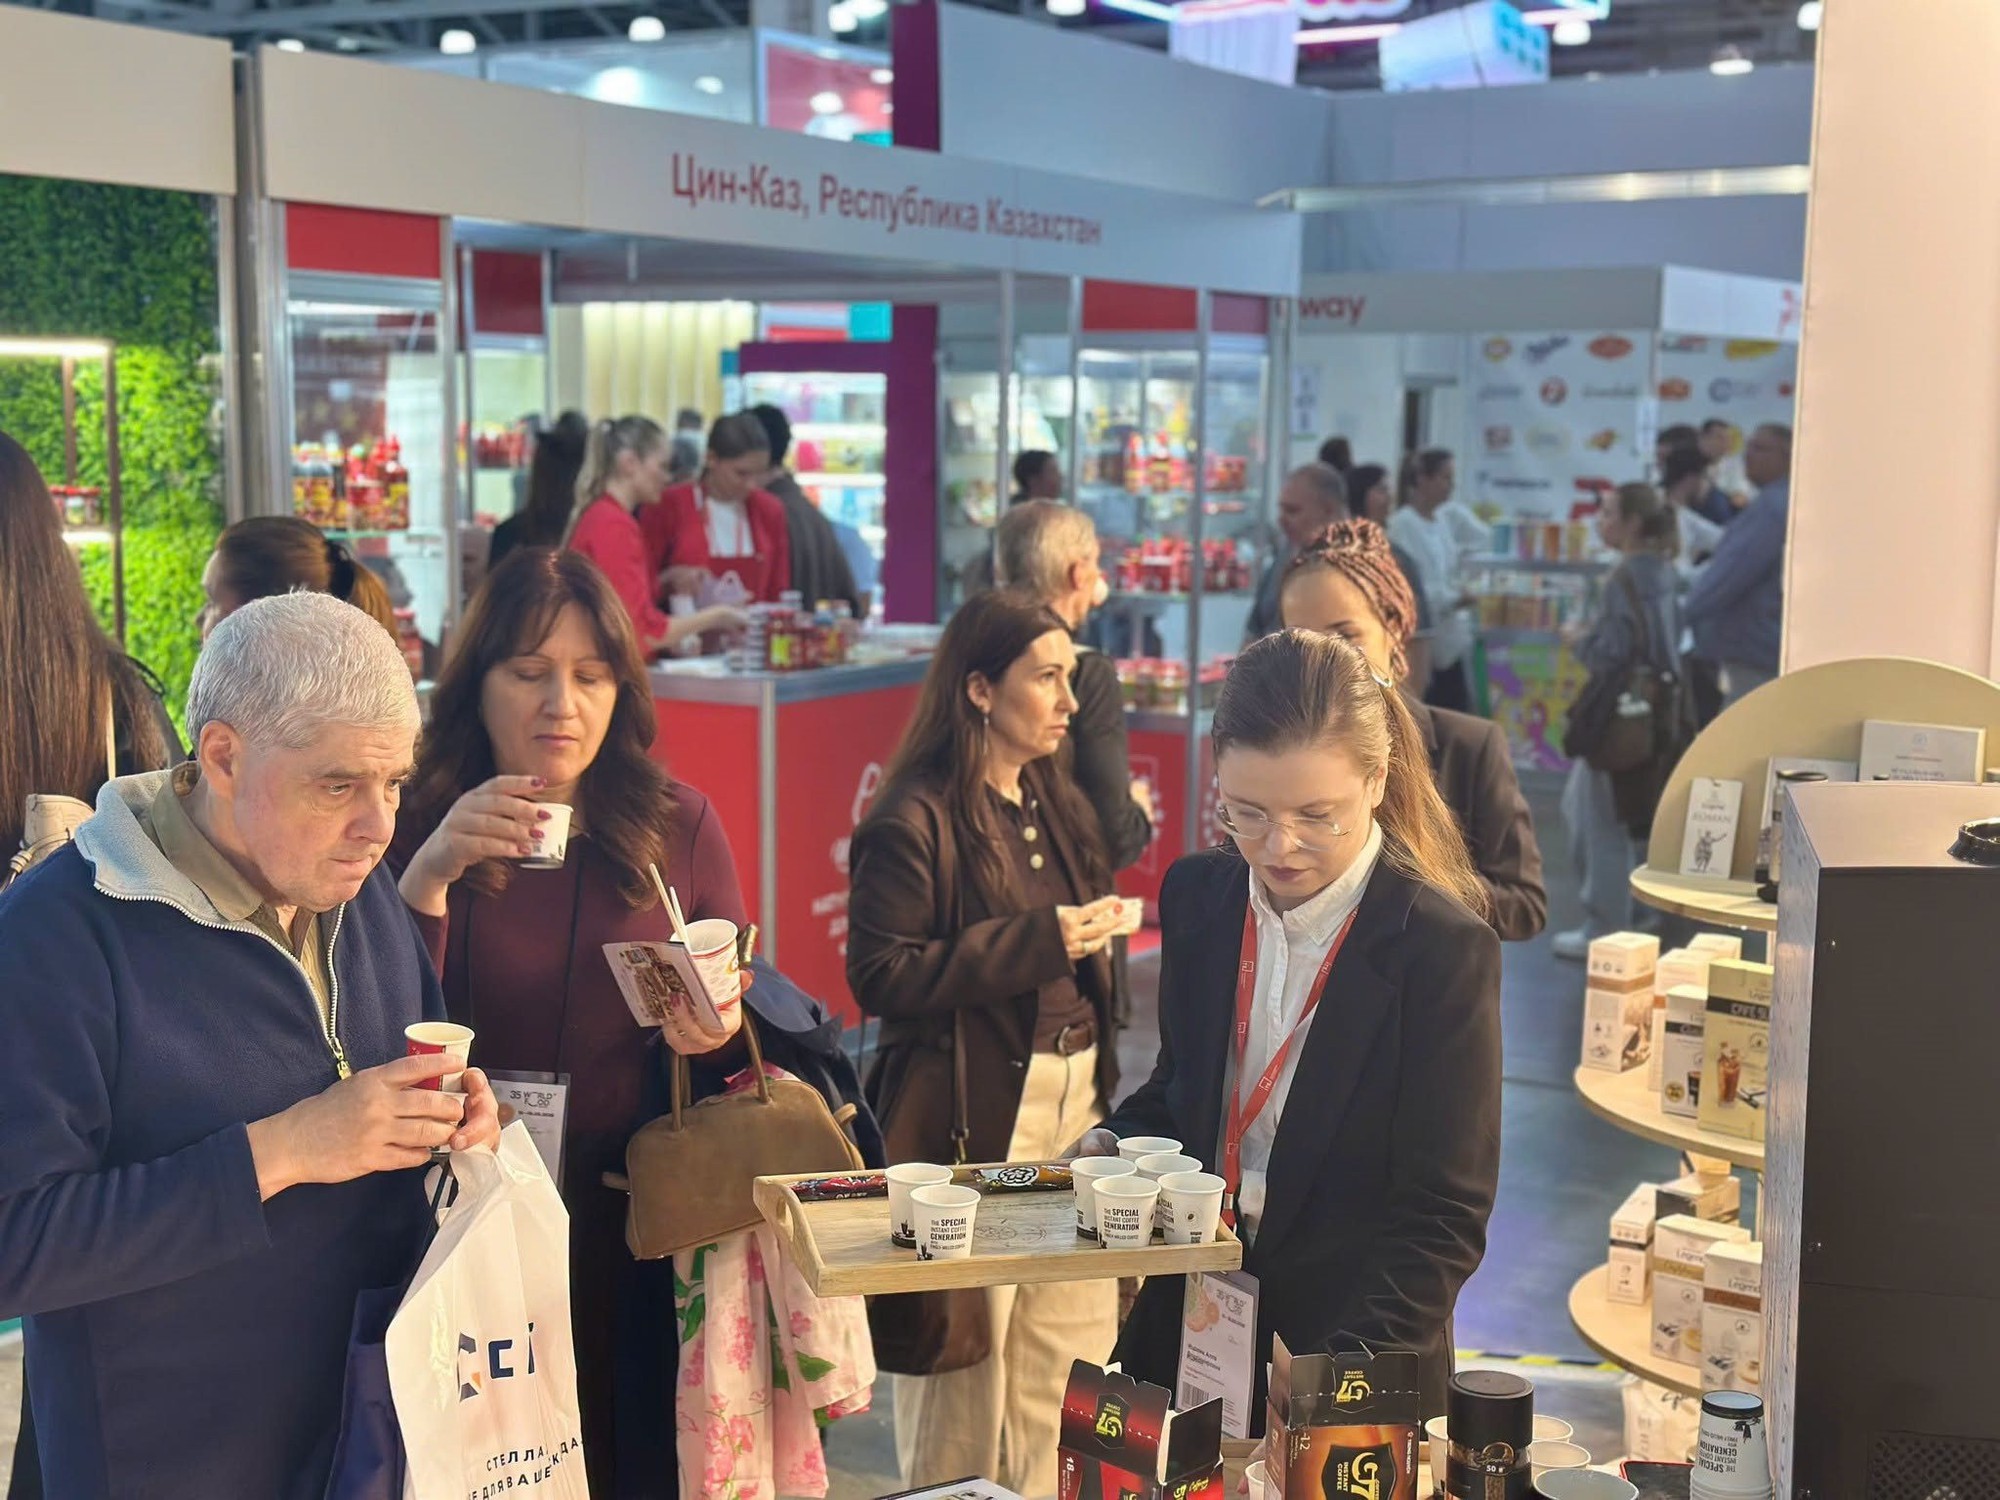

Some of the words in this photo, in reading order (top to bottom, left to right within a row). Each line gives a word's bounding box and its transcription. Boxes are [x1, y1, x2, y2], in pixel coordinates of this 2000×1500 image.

[672, 153, 809, 219] Цин-Каз,
[818, 174, 980, 233] Республика
[985, 195, 1101, 245] Казахстан
[1297, 295, 1367, 329] way
[1112, 1208, 1139, 1217] SPECIAL
[940, 1218, 966, 1227] SPECIAL
[1104, 1221, 1140, 1231] GENERATION
[1676, 1248, 1703, 1262] Legen
[1336, 1380, 1370, 1403] G7
[1096, 1412, 1123, 1438] G7
[486, 1445, 549, 1472] СТЕЛЛА
[1066, 1456, 1075, 1472] 18
